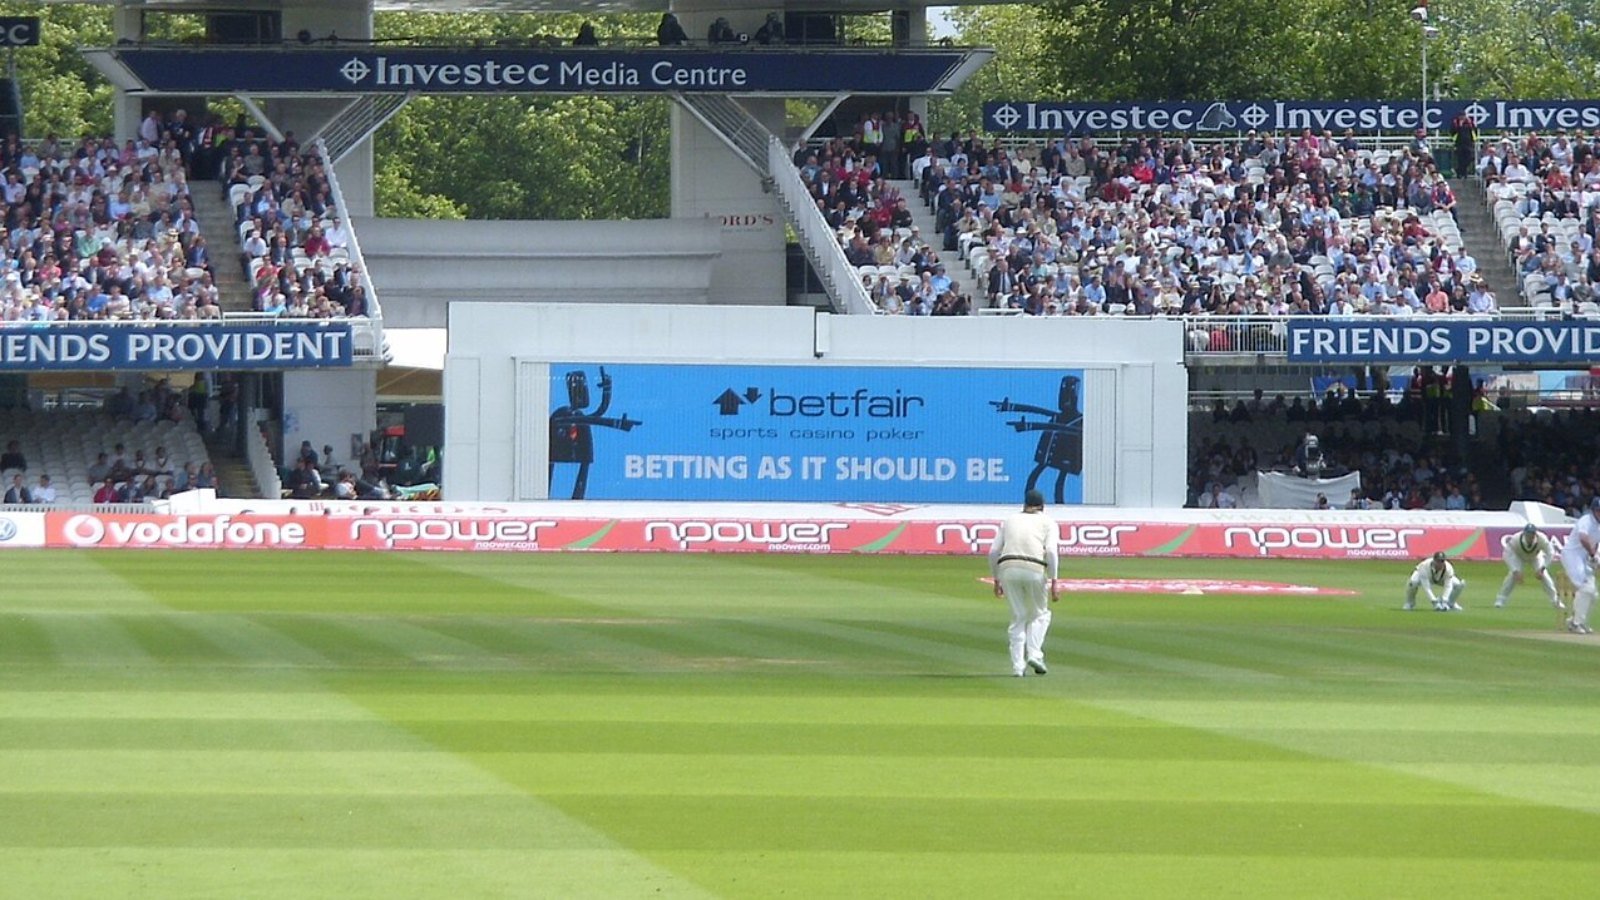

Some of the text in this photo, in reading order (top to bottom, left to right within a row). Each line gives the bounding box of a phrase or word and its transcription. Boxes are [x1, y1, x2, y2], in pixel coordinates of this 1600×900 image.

[376, 57, 747, 85] Investec Media Centre
[1027, 103, 1193, 130] Investec
[1275, 102, 1443, 129] Investec
[1495, 102, 1600, 128] Inves
[0, 331, 347, 362] ENDS PROVIDENT
[1292, 327, 1600, 355] FRIENDS PROVID
[769, 387, 925, 418] betfair
[710, 426, 925, 442] sports casino poker
[624, 455, 1010, 482] BETTING AS IT SHOULD BE.
[110, 515, 306, 544] vodafone
[351, 519, 557, 548] npower
[644, 522, 848, 550] npower
[1224, 527, 1424, 554] npower
